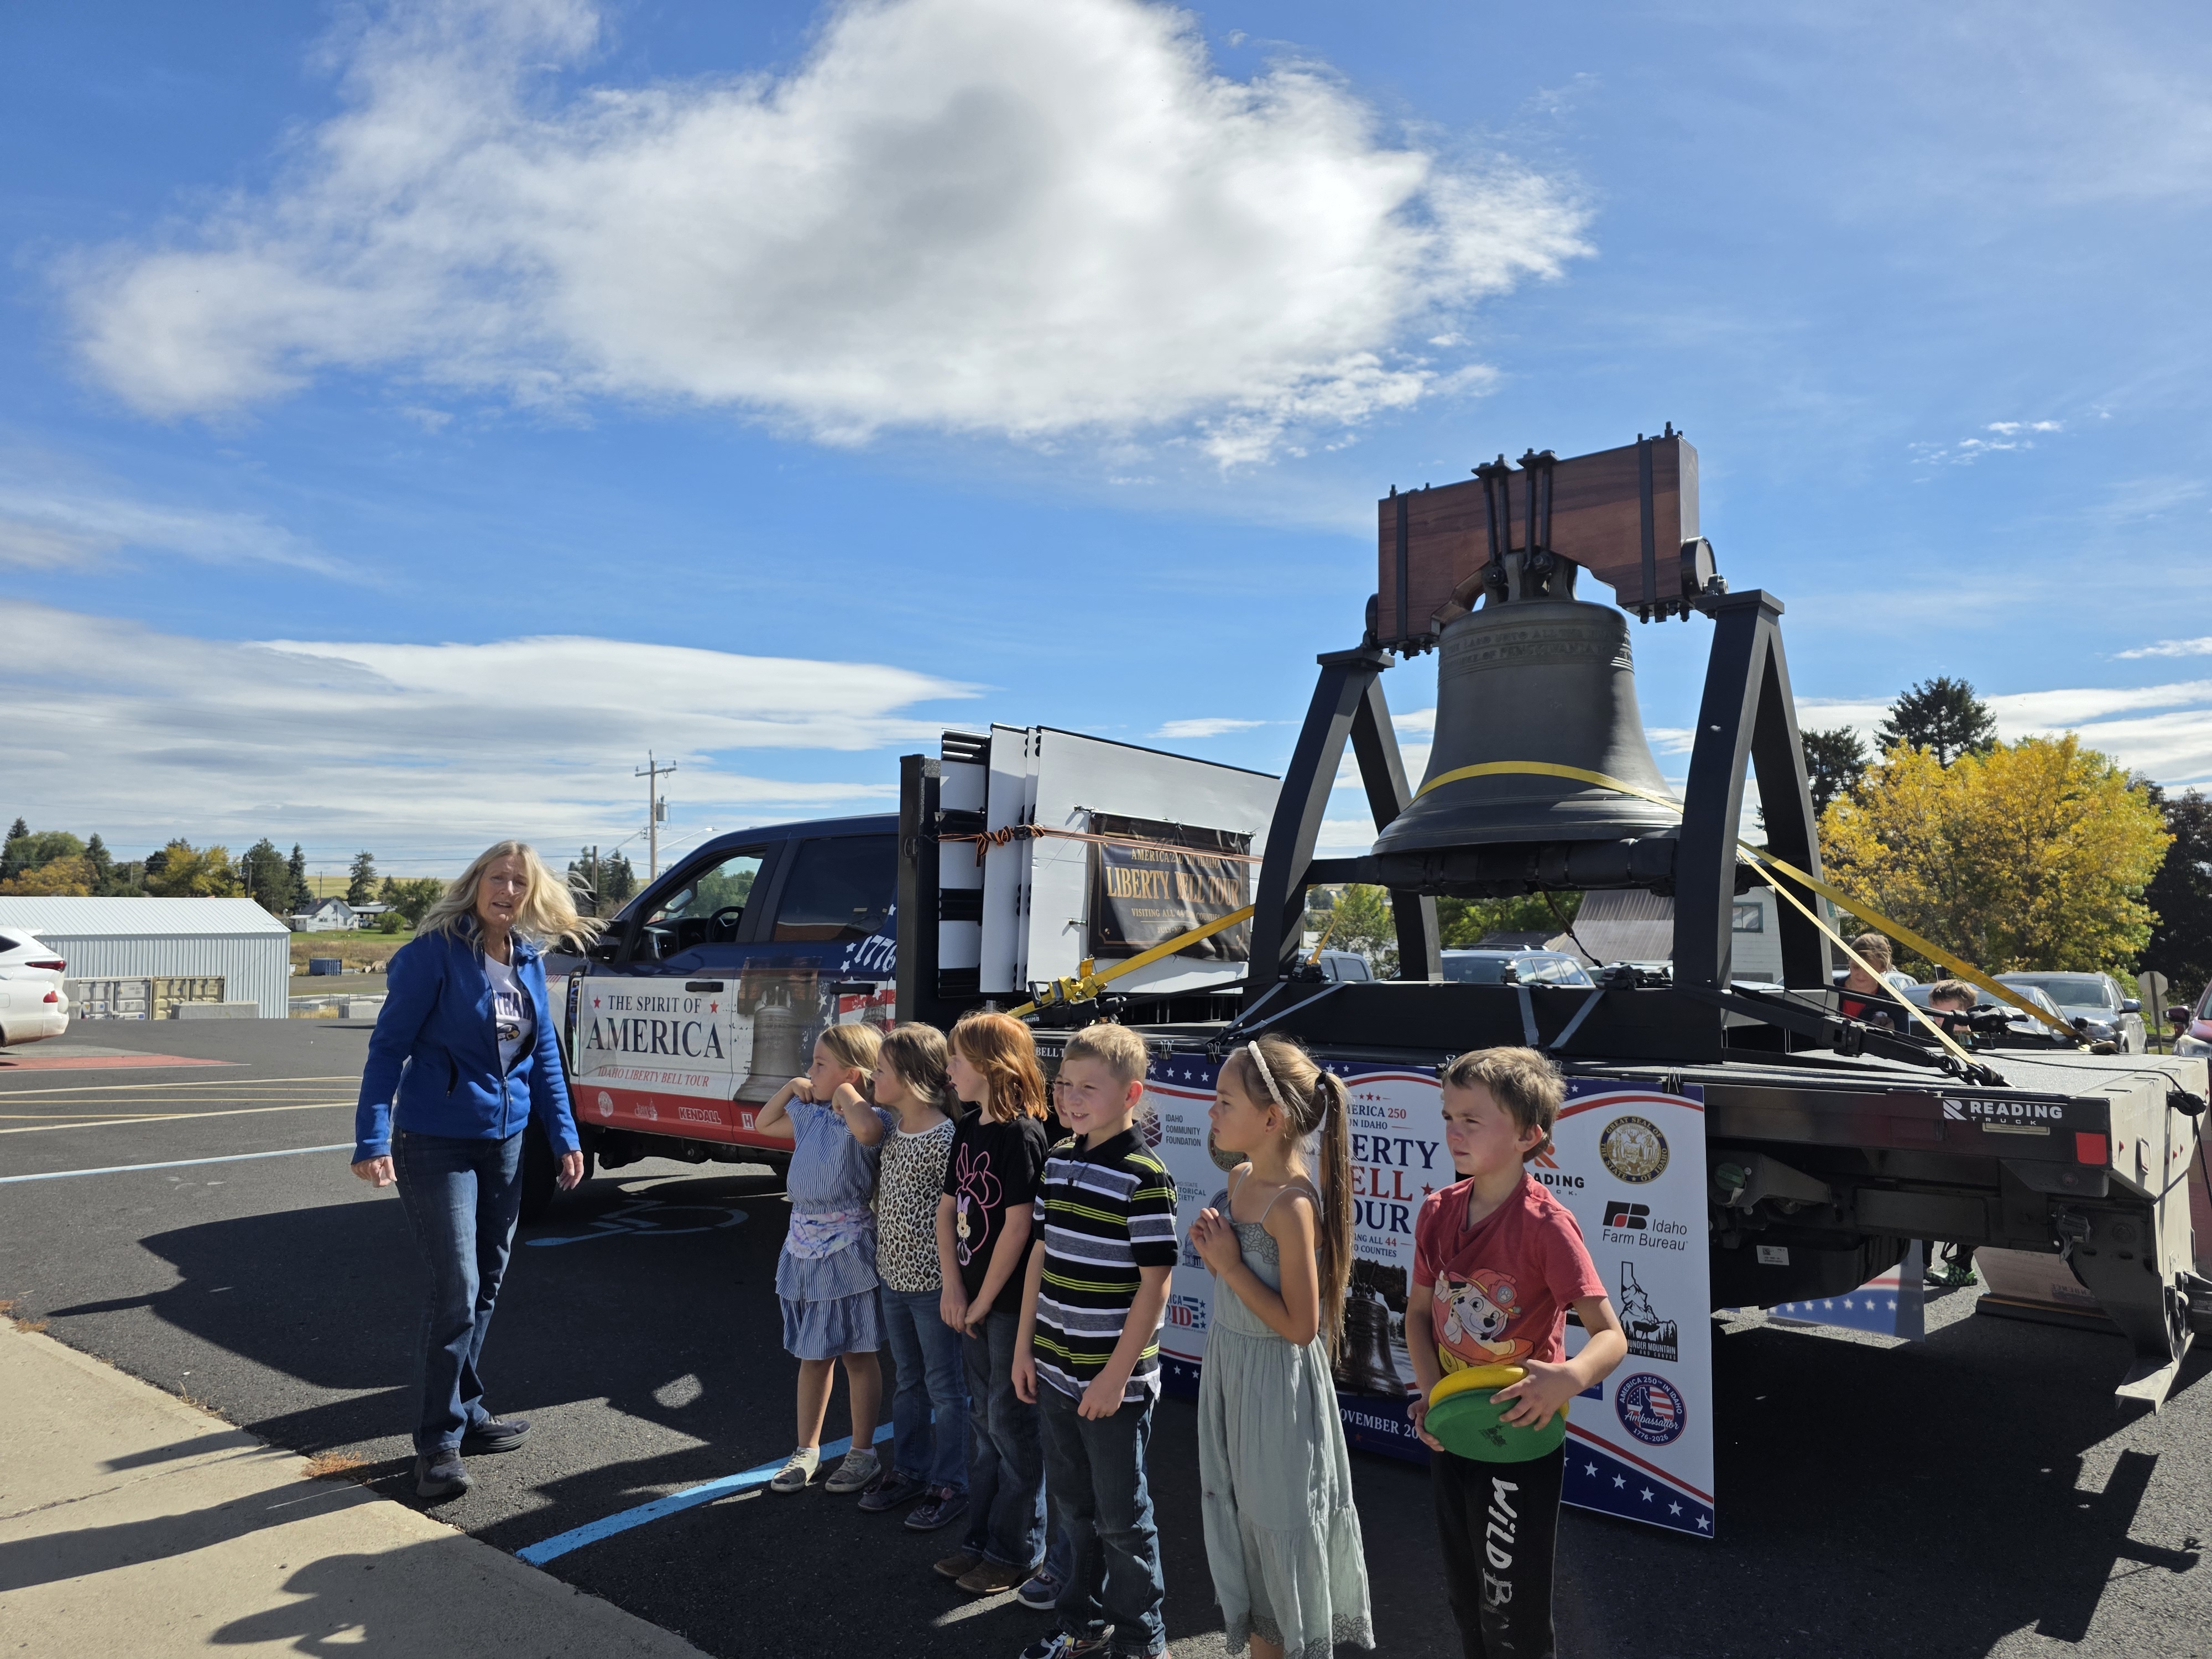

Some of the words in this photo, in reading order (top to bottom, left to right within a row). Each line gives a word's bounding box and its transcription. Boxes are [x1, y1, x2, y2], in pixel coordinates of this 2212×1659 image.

[1131, 848, 1170, 863] AMERICA
[1197, 856, 1220, 869] IDAHO
[1106, 866, 1170, 900] LIBERTY
[1175, 871, 1205, 903] BELL
[1208, 875, 1239, 906] TOUR
[1131, 908, 1160, 917] VISITING
[1162, 909, 1175, 917] ALL
[1177, 909, 1185, 917] 44
[854, 935, 897, 973] 1776
[608, 995, 632, 1010] THE
[637, 996, 680, 1012] SPIRIT
[684, 998, 702, 1013] OF
[586, 1017, 725, 1059] AMERICA
[1036, 1047, 1059, 1057] BELL
[597, 1066, 624, 1079] IDAHO
[625, 1068, 661, 1082] LIBERTY
[661, 1072, 684, 1084] BELL
[685, 1074, 709, 1087] TOUR
[679, 1107, 721, 1124] KENDALL
[1165, 1114, 1183, 1123] IDAHO
[1387, 1108, 1407, 1119] 250
[1970, 1101, 2062, 1119] READING
[1361, 1119, 1388, 1130] IDAHO
[1606, 1117, 1629, 1134] GREAT
[1631, 1117, 1651, 1129] SEAL
[1652, 1129, 1662, 1138] OF
[1971, 1116, 2037, 1125] TRUCK
[1166, 1125, 1200, 1136] COMMUNITY
[1166, 1136, 1201, 1147] FOUNDATION
[1351, 1133, 1439, 1170] ERTY
[1605, 1160, 1627, 1180] STATE
[1641, 1173, 1652, 1181] OF
[1656, 1147, 1668, 1174] IDAHO
[1350, 1165, 1413, 1202] ELL
[1534, 1172, 1584, 1188] ADING
[1178, 1187, 1206, 1196] TORICAL
[1652, 1218, 1687, 1235] Idaho
[1369, 1236, 1383, 1245] ALL
[1385, 1237, 1397, 1247] 44
[1603, 1229, 1634, 1245] Farm
[1639, 1233, 1686, 1251] Bureau
[1361, 1245, 1397, 1258] COUNTIES
[1627, 1339, 1647, 1350] UNDER
[1648, 1342, 1676, 1355] MOUNTAIN
[1619, 1377, 1642, 1404] AMERICA
[1662, 1384, 1670, 1392] IN
[1669, 1391, 1683, 1414] IDAHO
[1340, 1408, 1399, 1434] OVEMBER
[1404, 1423, 1419, 1439] 20
[1625, 1411, 1679, 1430] Ambassador
[1633, 1428, 1669, 1442] 1776-2026
